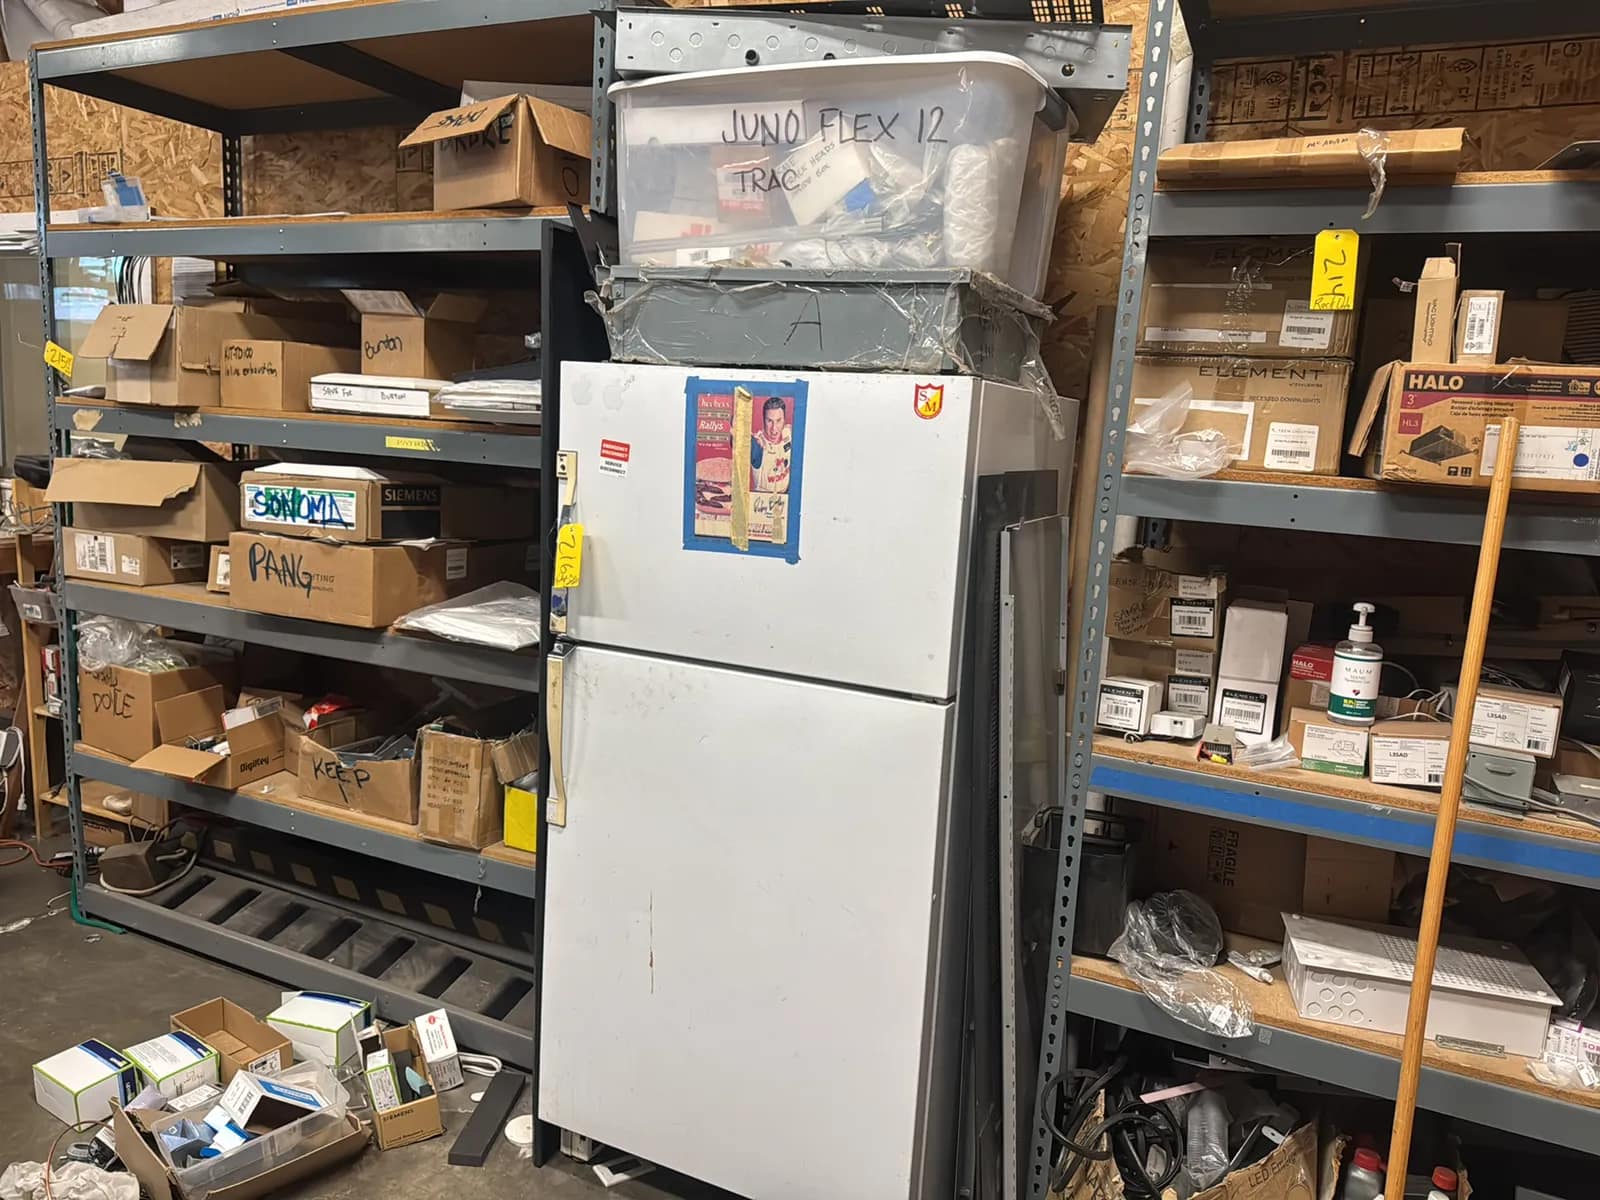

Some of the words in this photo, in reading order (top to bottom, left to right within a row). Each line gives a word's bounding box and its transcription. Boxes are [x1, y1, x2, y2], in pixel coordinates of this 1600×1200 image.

[721, 109, 800, 146] JUNO
[818, 107, 899, 144] FLEX
[917, 105, 949, 144] 12
[733, 167, 801, 193] TRAC
[1317, 248, 1346, 297] 214
[785, 294, 823, 352] A
[1199, 365, 1325, 381] ELEMENT
[1408, 374, 1464, 391] HALO
[919, 391, 928, 401] S
[925, 401, 937, 412] M
[1402, 419, 1420, 427] HL3
[385, 488, 438, 502] SIEMENS
[253, 487, 350, 530] SONOMA
[559, 534, 577, 574] 216
[249, 542, 313, 599] PANG
[1293, 660, 1314, 668] HALO
[1345, 666, 1373, 675] MAUM
[239, 755, 270, 773] DigiKey
[312, 758, 371, 790] KEEP
[1223, 830, 1239, 887] FRAGILE
[1248, 1168, 1270, 1188] LED
